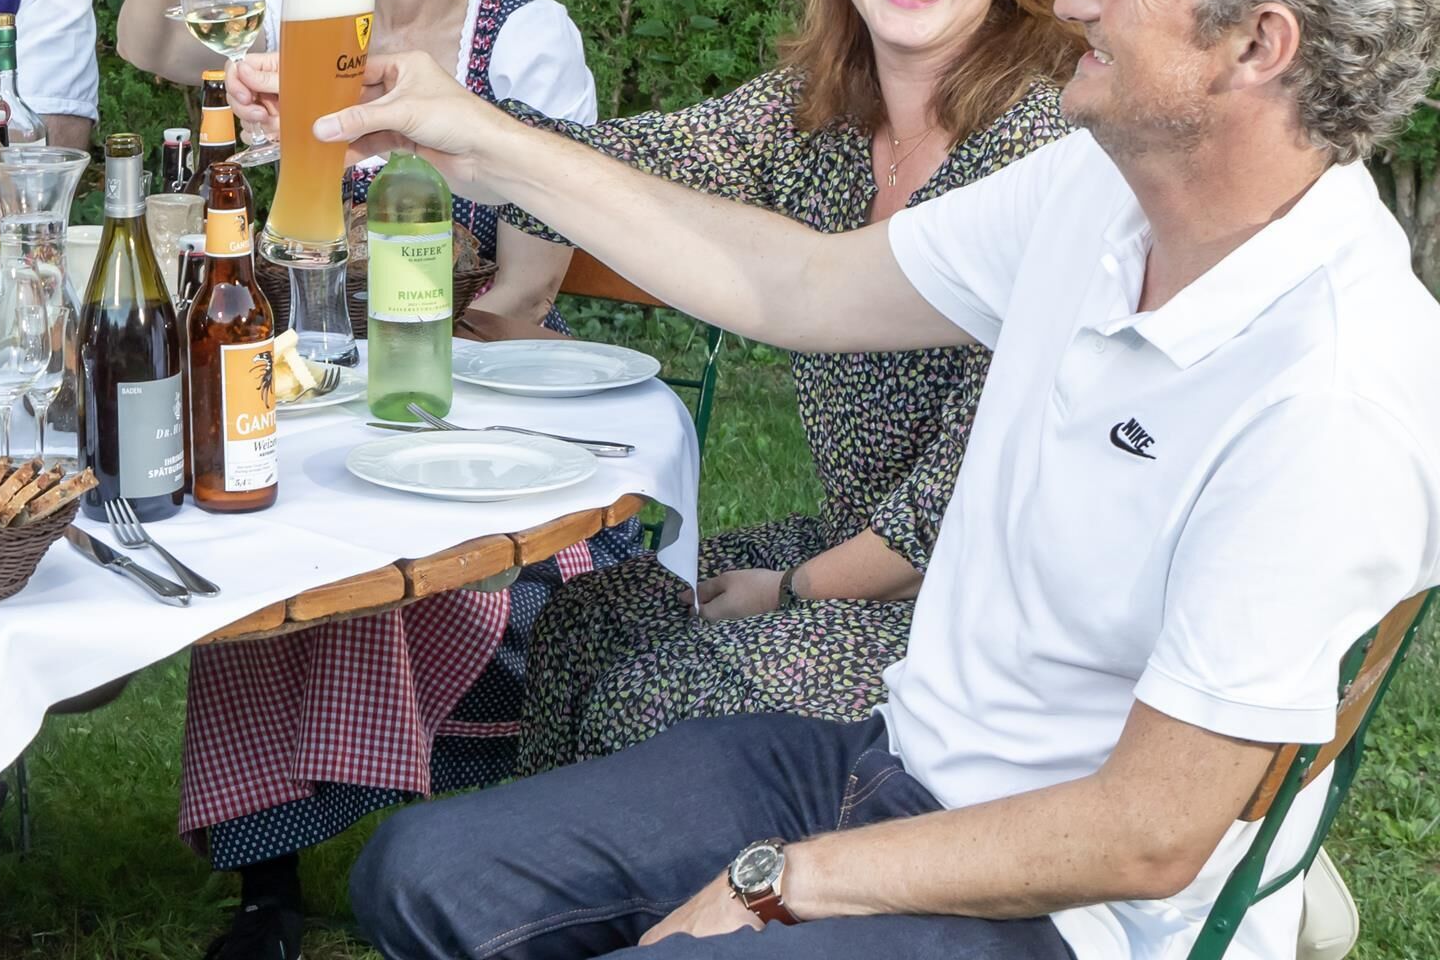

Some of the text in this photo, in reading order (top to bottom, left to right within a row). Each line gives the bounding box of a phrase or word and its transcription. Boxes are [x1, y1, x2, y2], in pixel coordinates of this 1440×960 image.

[401, 245, 442, 257] KIEFER
[398, 288, 444, 300] RIVANER
[1121, 417, 1155, 454] NIKE
